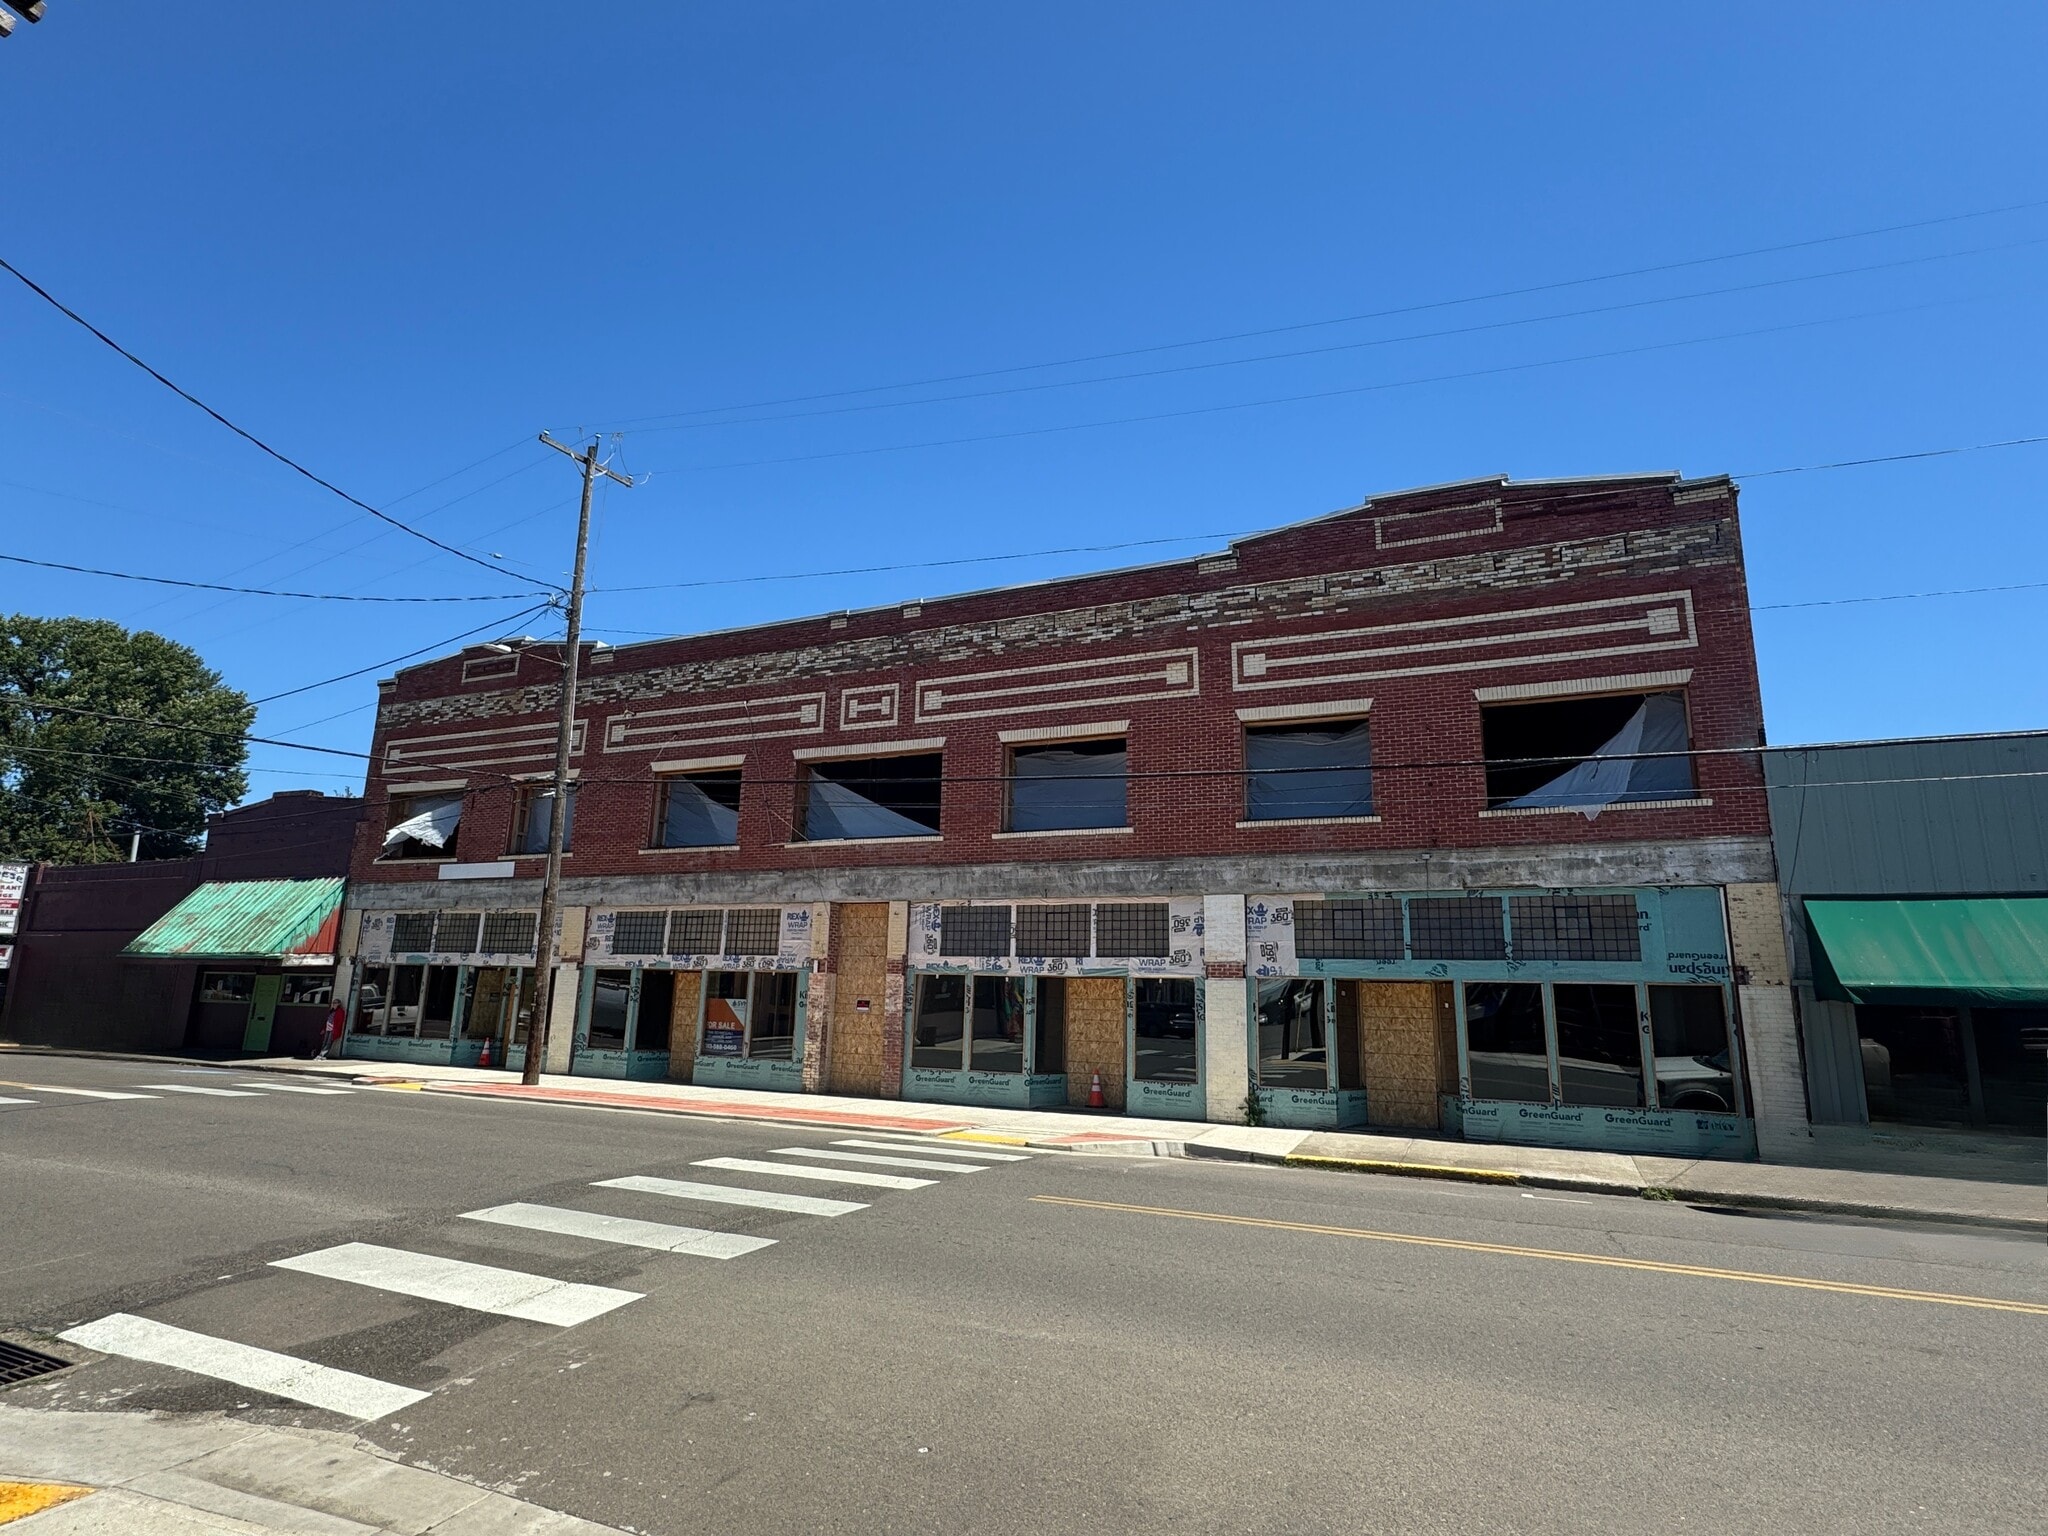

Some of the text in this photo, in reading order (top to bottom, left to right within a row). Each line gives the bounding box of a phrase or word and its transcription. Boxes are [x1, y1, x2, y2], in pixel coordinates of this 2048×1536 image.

[1271, 913, 1288, 922] 360
[1265, 944, 1275, 963] 360
[1139, 958, 1166, 966] WRAP
[1169, 954, 1186, 964] 360
[1047, 962, 1063, 972] 360
[718, 1021, 735, 1029] SALE
[726, 1061, 760, 1070] GreenGuard
[915, 1074, 956, 1083] GreenGuard
[969, 1076, 1011, 1086] GreenGuard
[1143, 1086, 1191, 1098] GreenGuard
[1519, 1108, 1583, 1121] GreenGuard
[1605, 1114, 1673, 1127] GreenGuard
